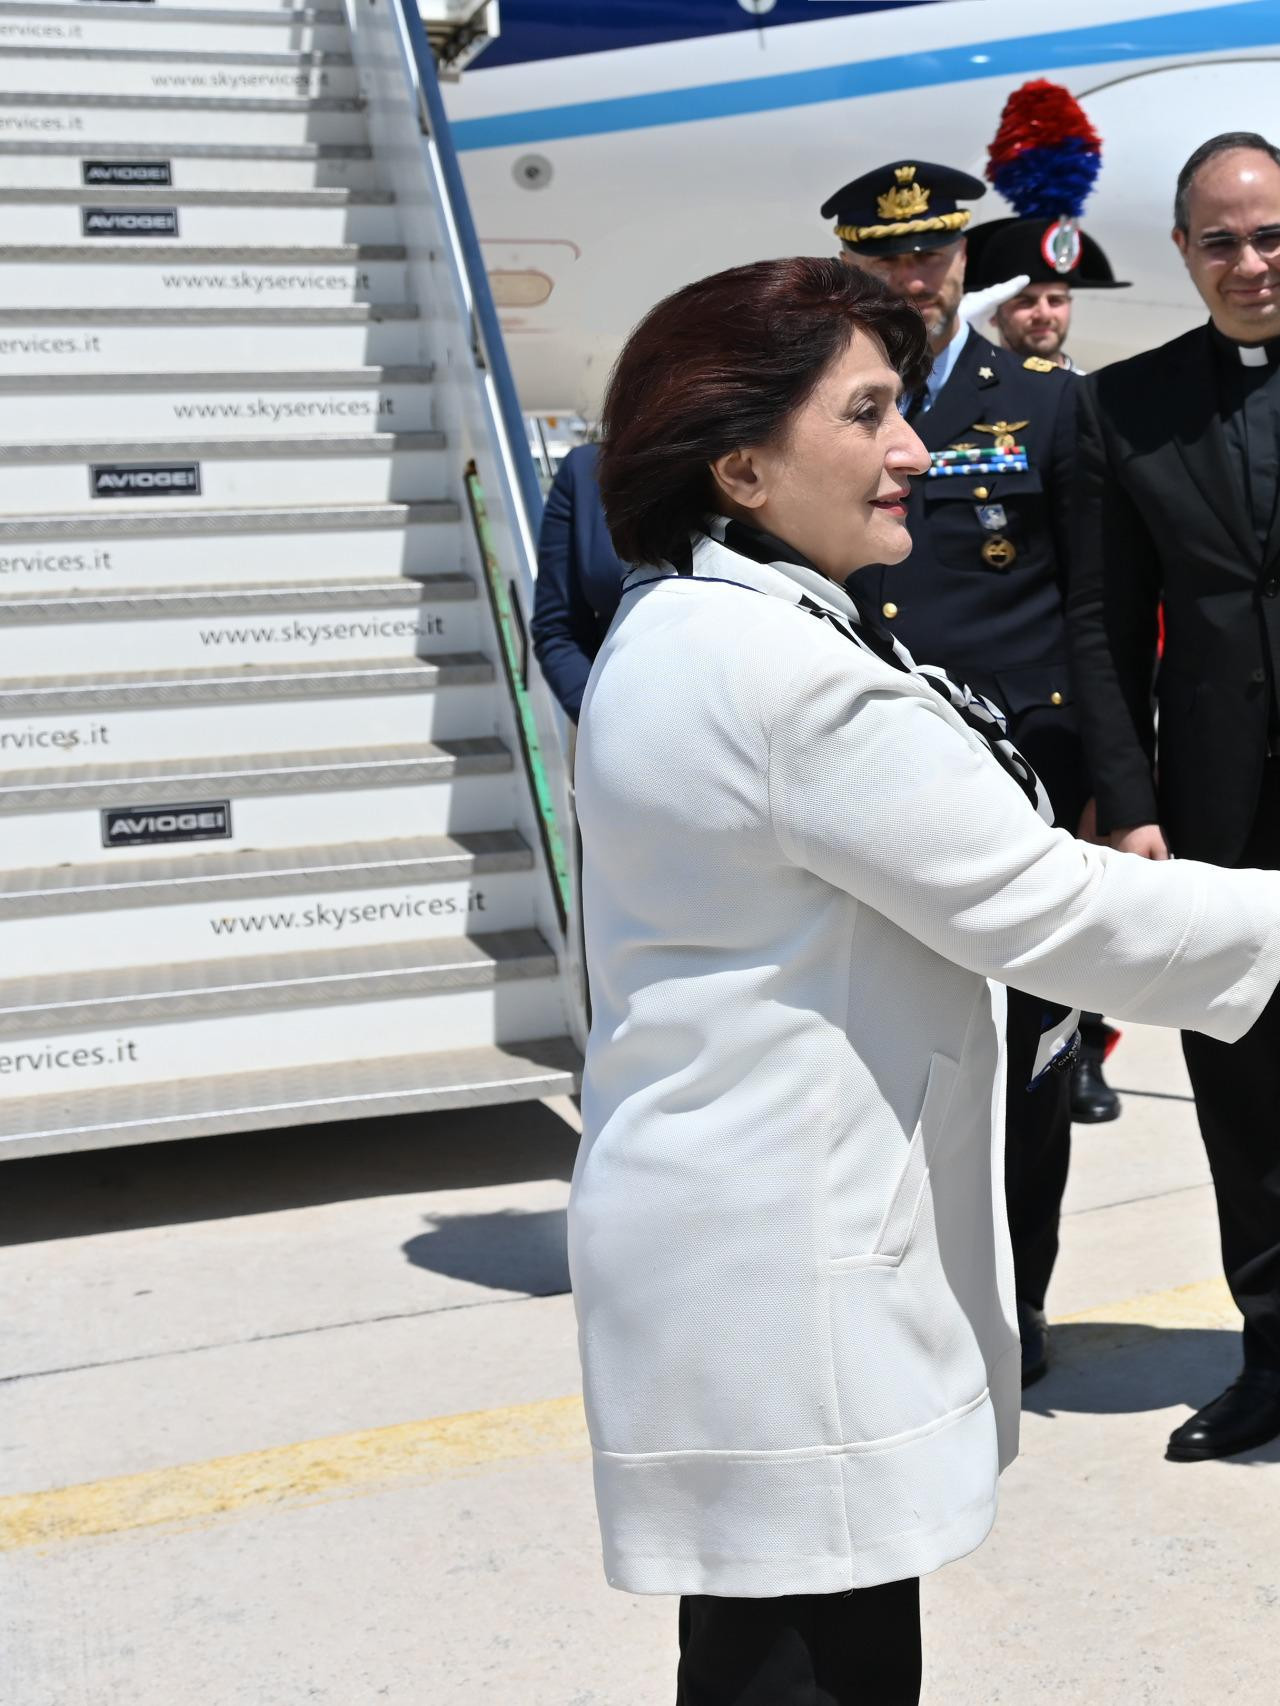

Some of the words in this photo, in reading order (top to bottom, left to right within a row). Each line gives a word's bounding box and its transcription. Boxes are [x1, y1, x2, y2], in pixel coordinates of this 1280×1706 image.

[88, 214, 174, 229] AVIOGEI
[161, 269, 371, 293] www.skyservices.it
[172, 396, 395, 422] www.skyservices.it
[98, 471, 194, 488] AVIOGEI
[0, 549, 112, 573] ervices.it
[199, 614, 444, 646] www.skyservices.it
[0, 722, 109, 748] rvices.it
[110, 811, 224, 835] AVIOGEI
[210, 888, 486, 935] www.skyservices.it
[0, 1038, 138, 1074] ervices.it
